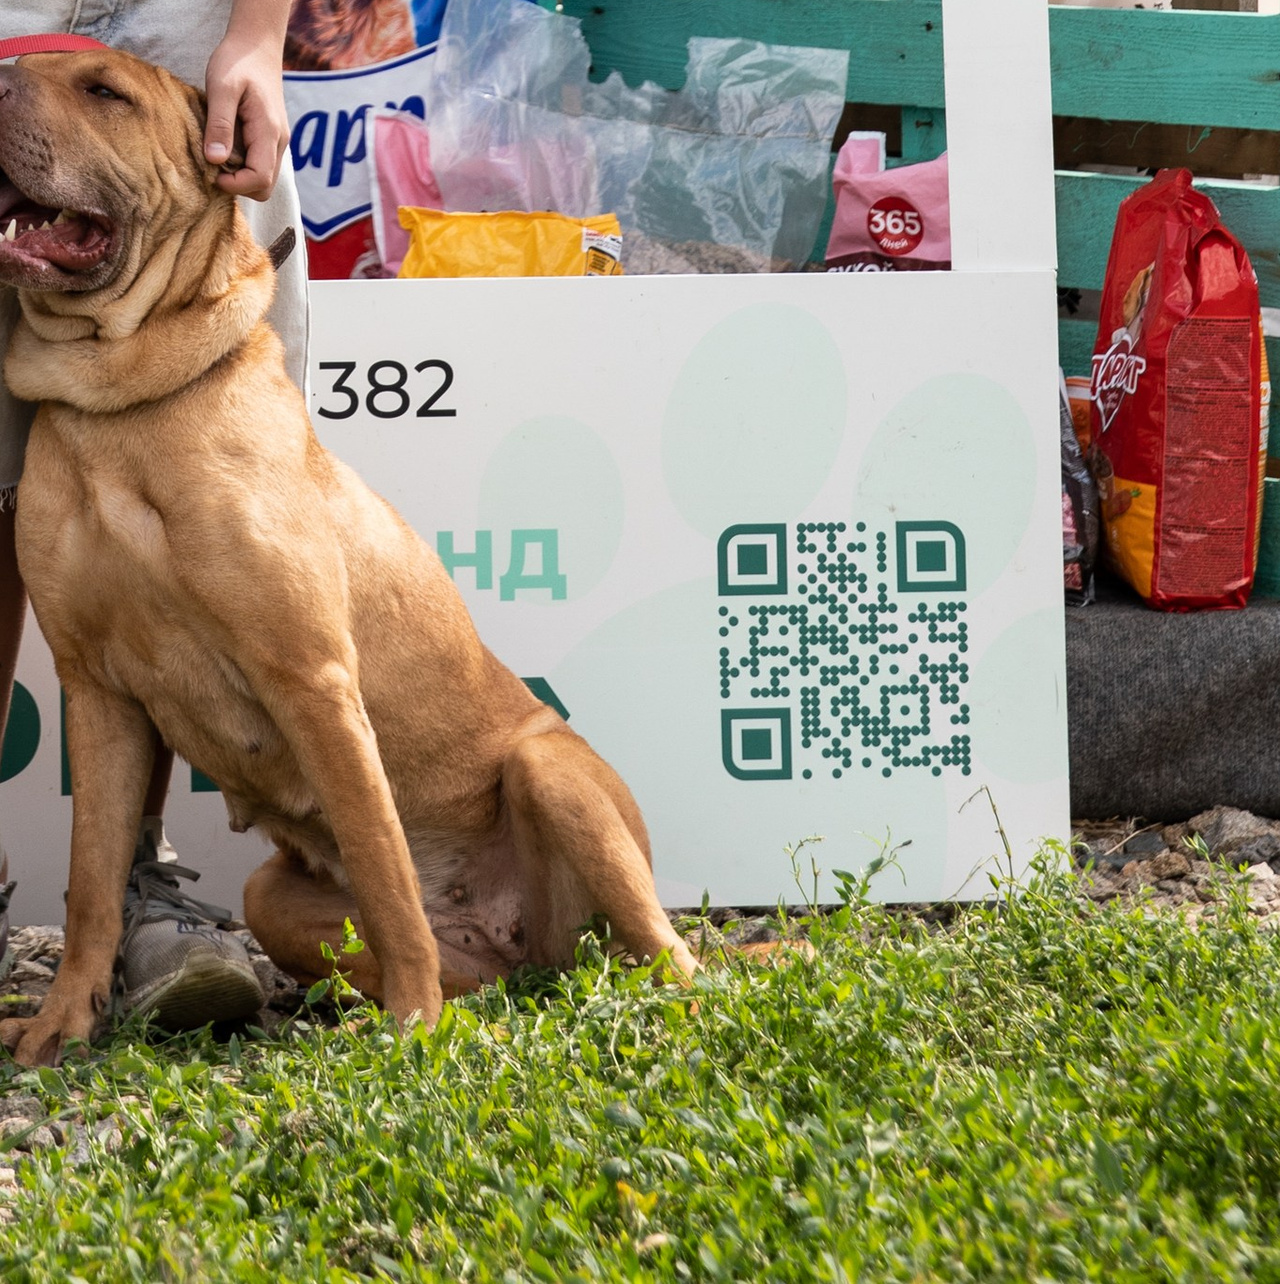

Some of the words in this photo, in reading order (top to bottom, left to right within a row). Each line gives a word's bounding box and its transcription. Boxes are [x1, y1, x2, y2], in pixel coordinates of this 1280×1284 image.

[869, 208, 922, 236] 365
[317, 359, 458, 420] 382
[437, 528, 567, 601] НД
